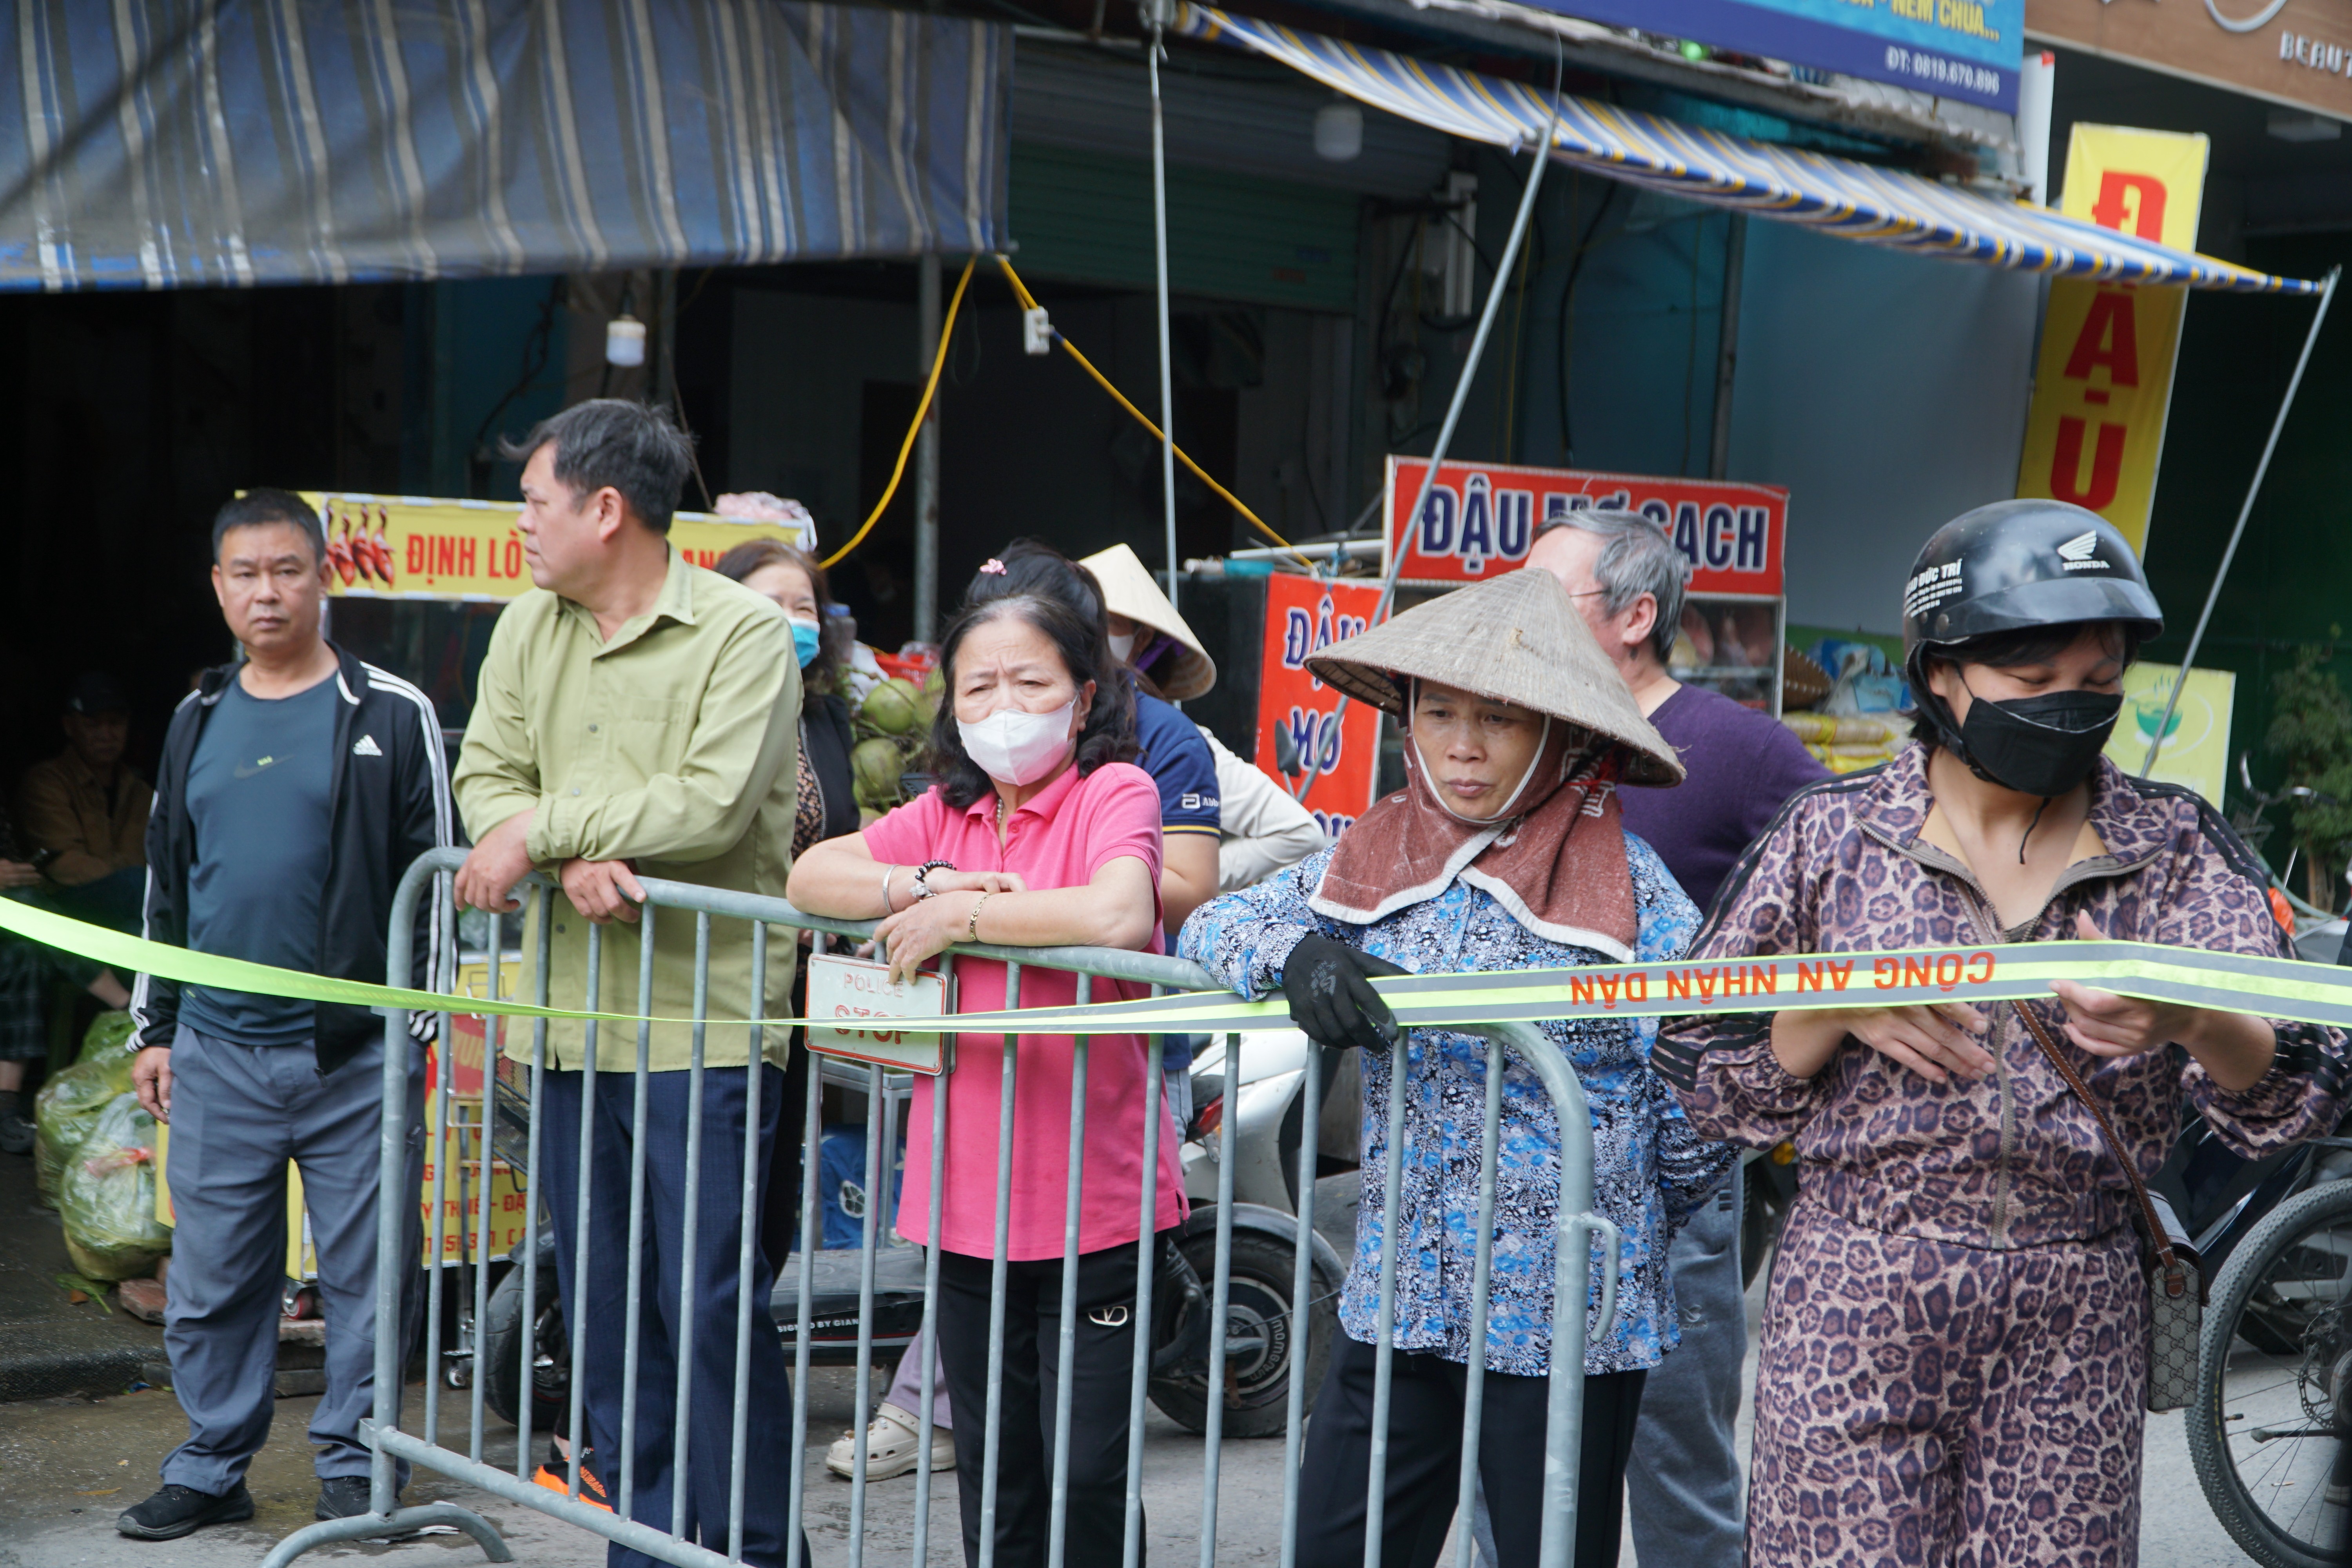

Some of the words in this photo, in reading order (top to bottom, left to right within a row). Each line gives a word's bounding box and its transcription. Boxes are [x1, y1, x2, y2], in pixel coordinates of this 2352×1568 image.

[1417, 472, 1534, 574] ĐẬU
[407, 533, 475, 585] ĐỊNH
[488, 529, 522, 579] LÒ
[2063, 560, 2110, 571] HONDA
[844, 972, 903, 997] POLICE
[1570, 972, 1648, 1010] DÂN
[1666, 964, 1778, 1005] NHÂN
[1797, 959, 1855, 993] AN
[1873, 951, 1996, 992] CÔNG
